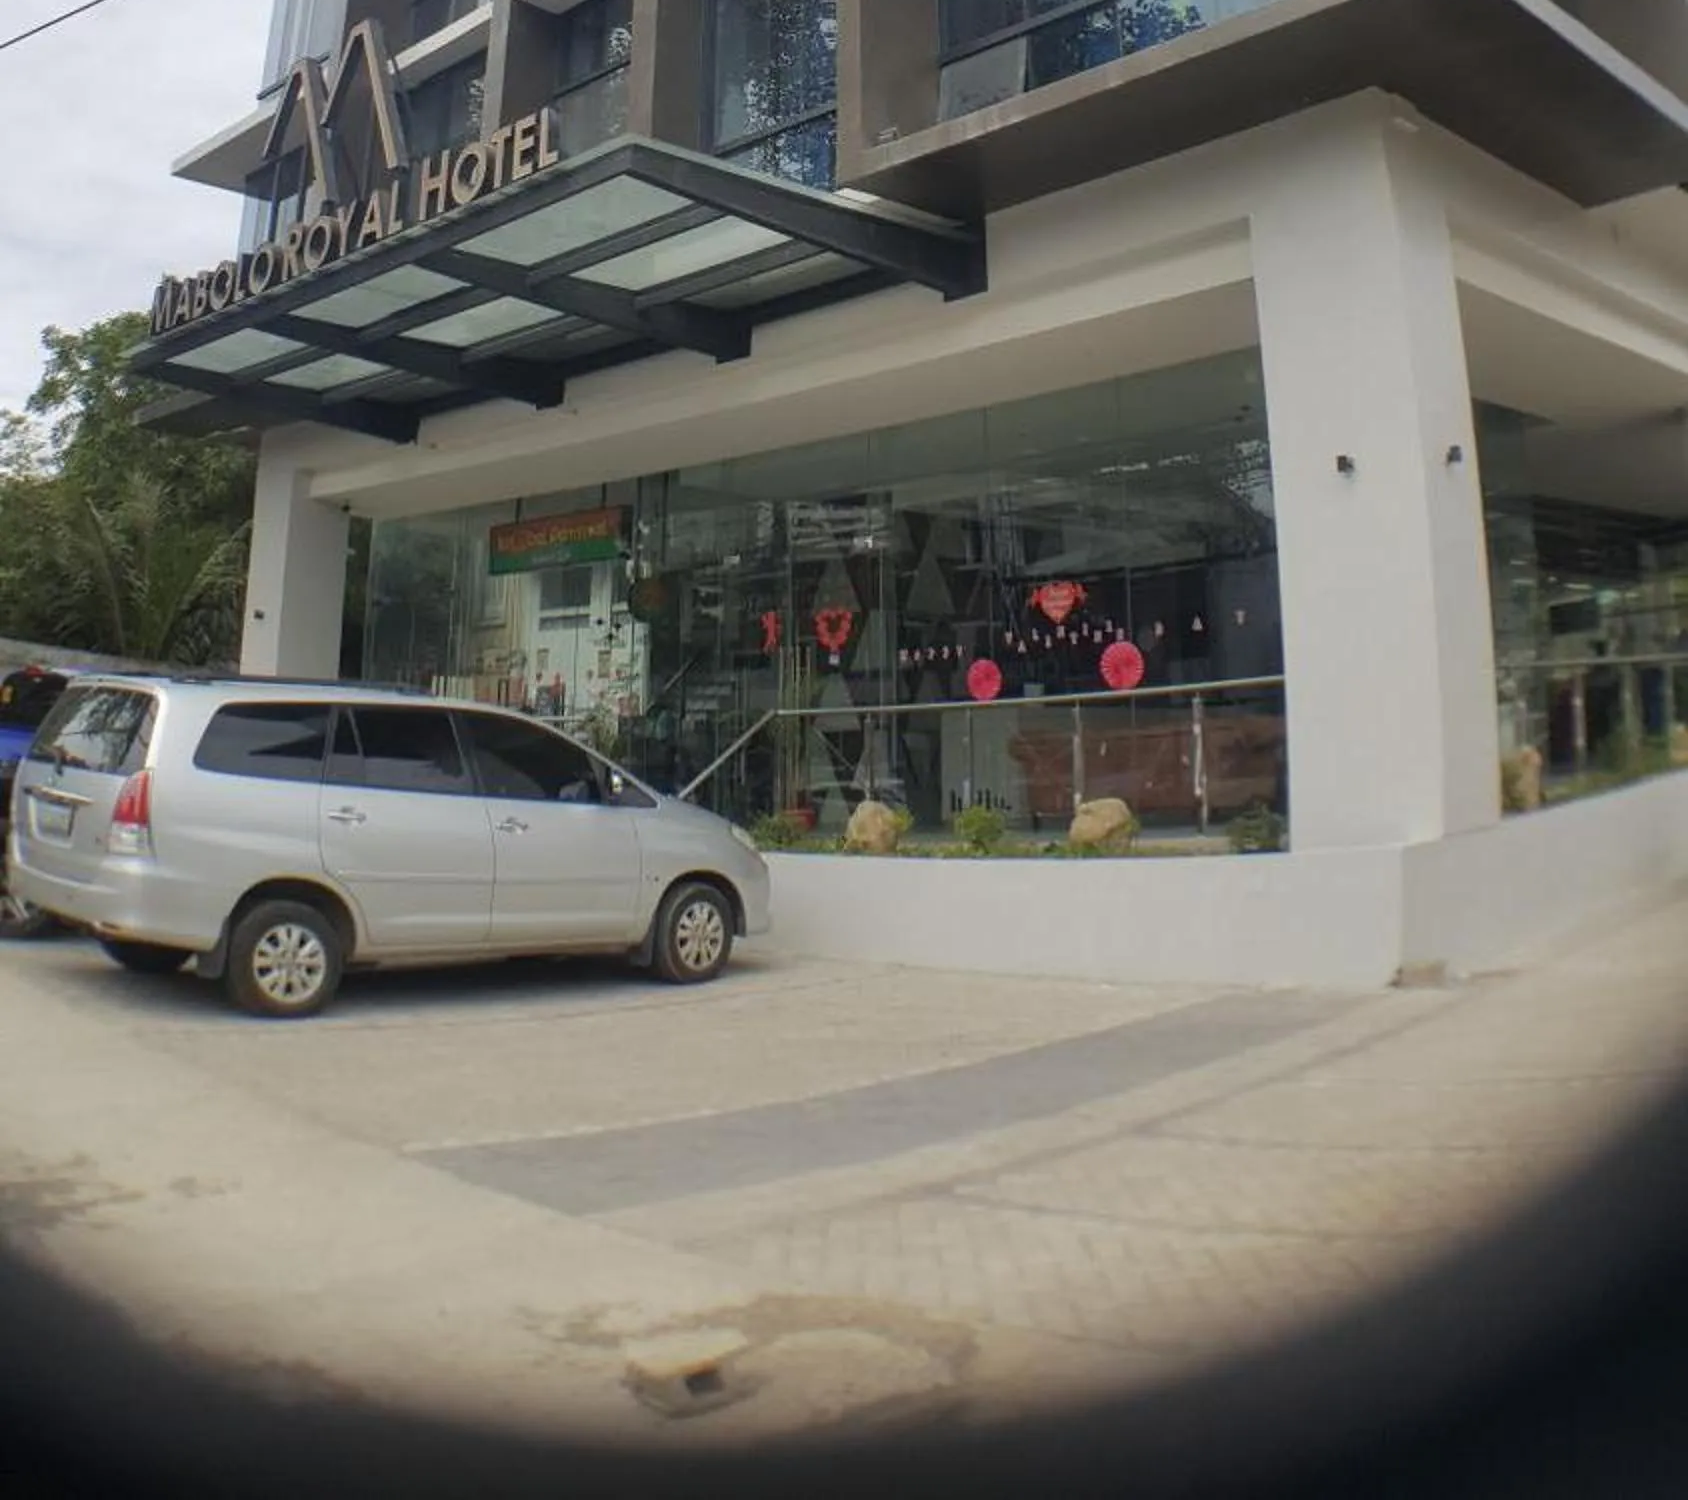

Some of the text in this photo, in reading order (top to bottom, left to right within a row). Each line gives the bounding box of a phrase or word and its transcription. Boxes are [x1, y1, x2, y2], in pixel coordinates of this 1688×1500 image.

[151, 107, 559, 334] MABOLO ROYAL HOTEL
